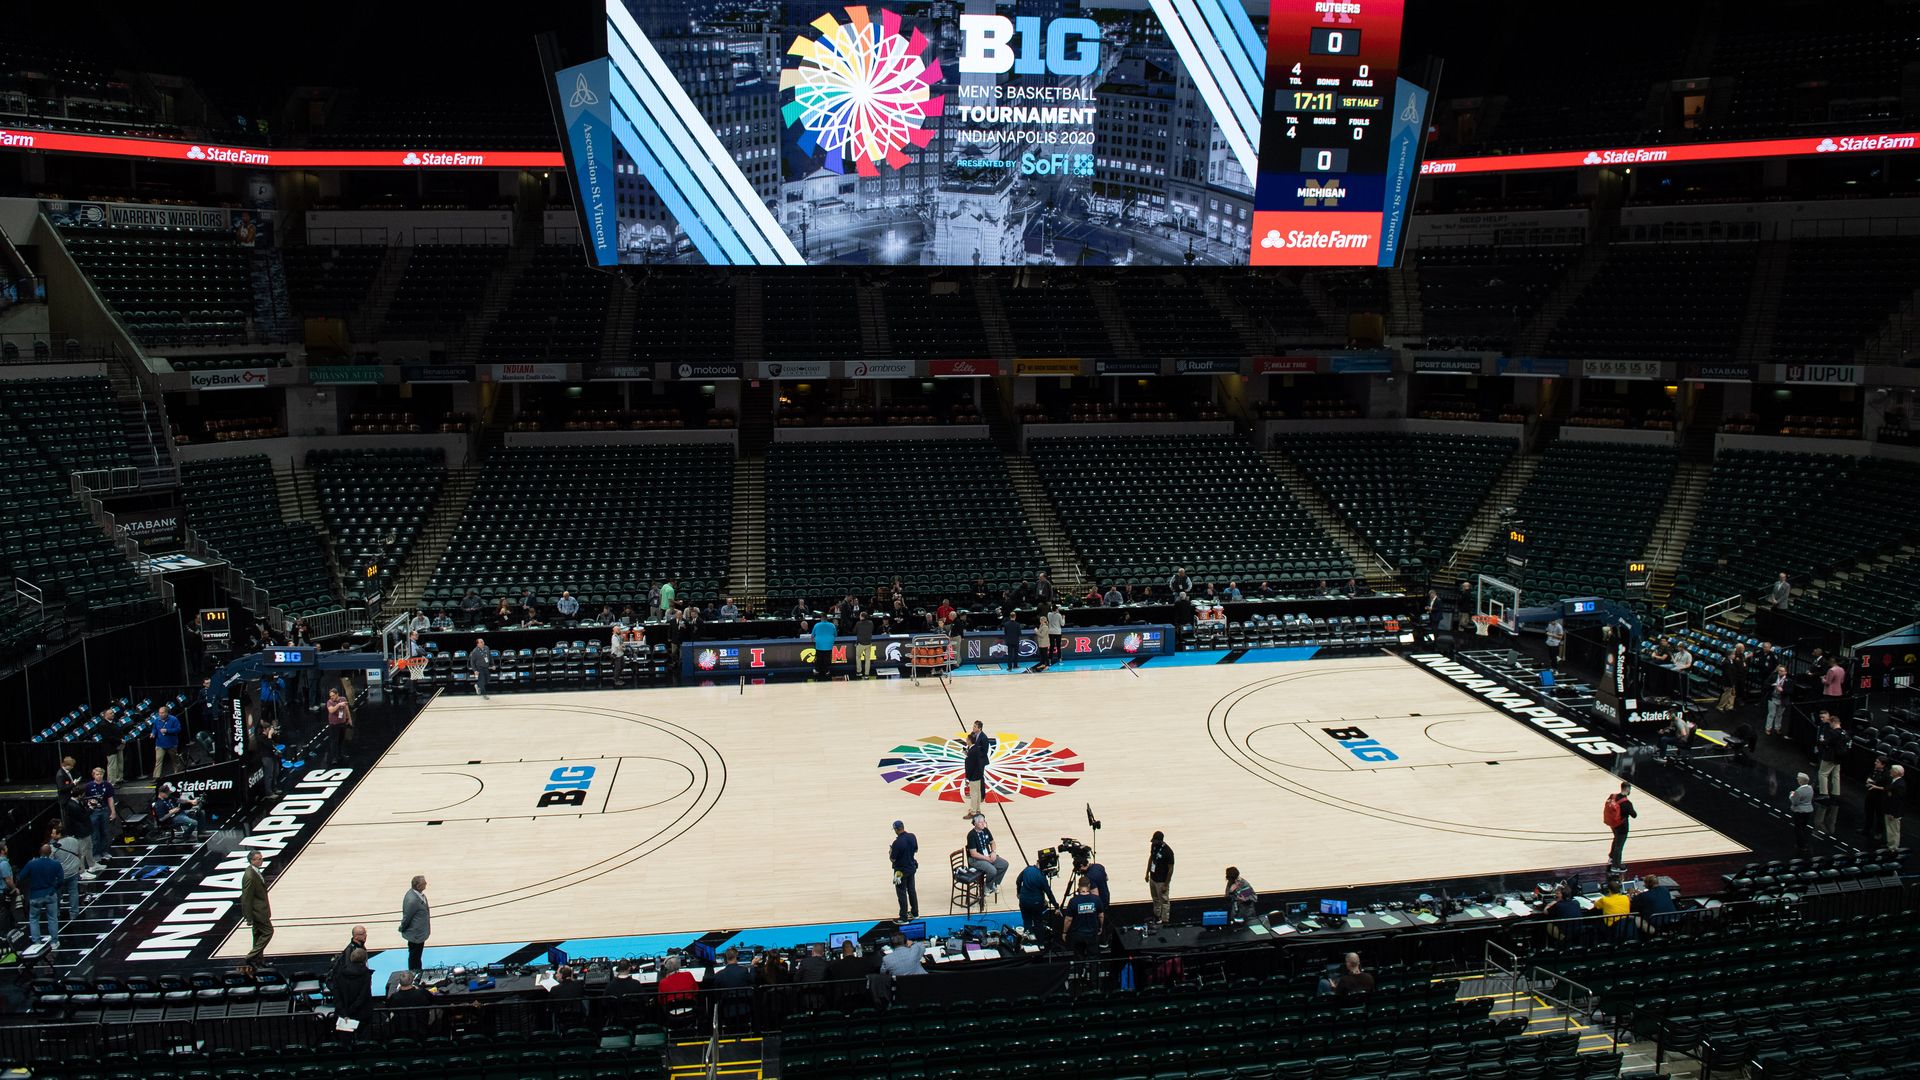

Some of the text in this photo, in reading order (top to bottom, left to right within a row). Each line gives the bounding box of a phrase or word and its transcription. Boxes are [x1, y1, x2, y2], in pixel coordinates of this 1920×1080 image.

[1315, 2, 1360, 14] RUTGERS
[1328, 32, 1343, 53] 0
[1292, 62, 1302, 76] 4
[1359, 65, 1369, 78] 0
[1316, 78, 1340, 86] BONUS
[1352, 79, 1373, 87] FOULS
[958, 85, 1097, 101] MEN'S BASKETBALL
[1293, 92, 1333, 111] 17:11
[1342, 98, 1379, 108] 1ST HALF
[958, 106, 1097, 125] TOURNAMENT
[1313, 117, 1336, 125] BONUS
[1349, 118, 1370, 126] FOULS
[957, 130, 1096, 145] INDIANAPOLIS 2020
[1286, 127, 1296, 139] 4
[1353, 127, 1363, 140] 0
[957, 159, 1016, 168] PRESENTED BY
[1021, 153, 1069, 175] SoFi
[1317, 150, 1332, 171] 0
[583, 122, 607, 249] Ascension St. Vincent
[1297, 187, 1346, 199] MICHIGAN
[1386, 136, 1410, 252] Ascension St. Vincent
[112, 208, 222, 227] WARREN'S WARRIORS
[503, 364, 535, 374] INDIANA
[693, 366, 736, 375] motorola
[868, 363, 906, 373] ambrose
[952, 361, 976, 374] Lilly
[1188, 361, 1213, 369] Ruoff
[1441, 362, 1480, 370] GRAPHICS
[1701, 367, 1749, 375] DATABANK
[191, 374, 240, 386] KeyBank
[309, 370, 350, 380] EMBASSY
[1808, 366, 1854, 382] IUPUI
[1075, 637, 1092, 652] R
[274, 652, 302, 662] B1G
[1409, 653, 1627, 755] INDIANAPOLIS
[1595, 700, 1610, 714] SoFi
[125, 768, 353, 961] INDIANAPOLIS
